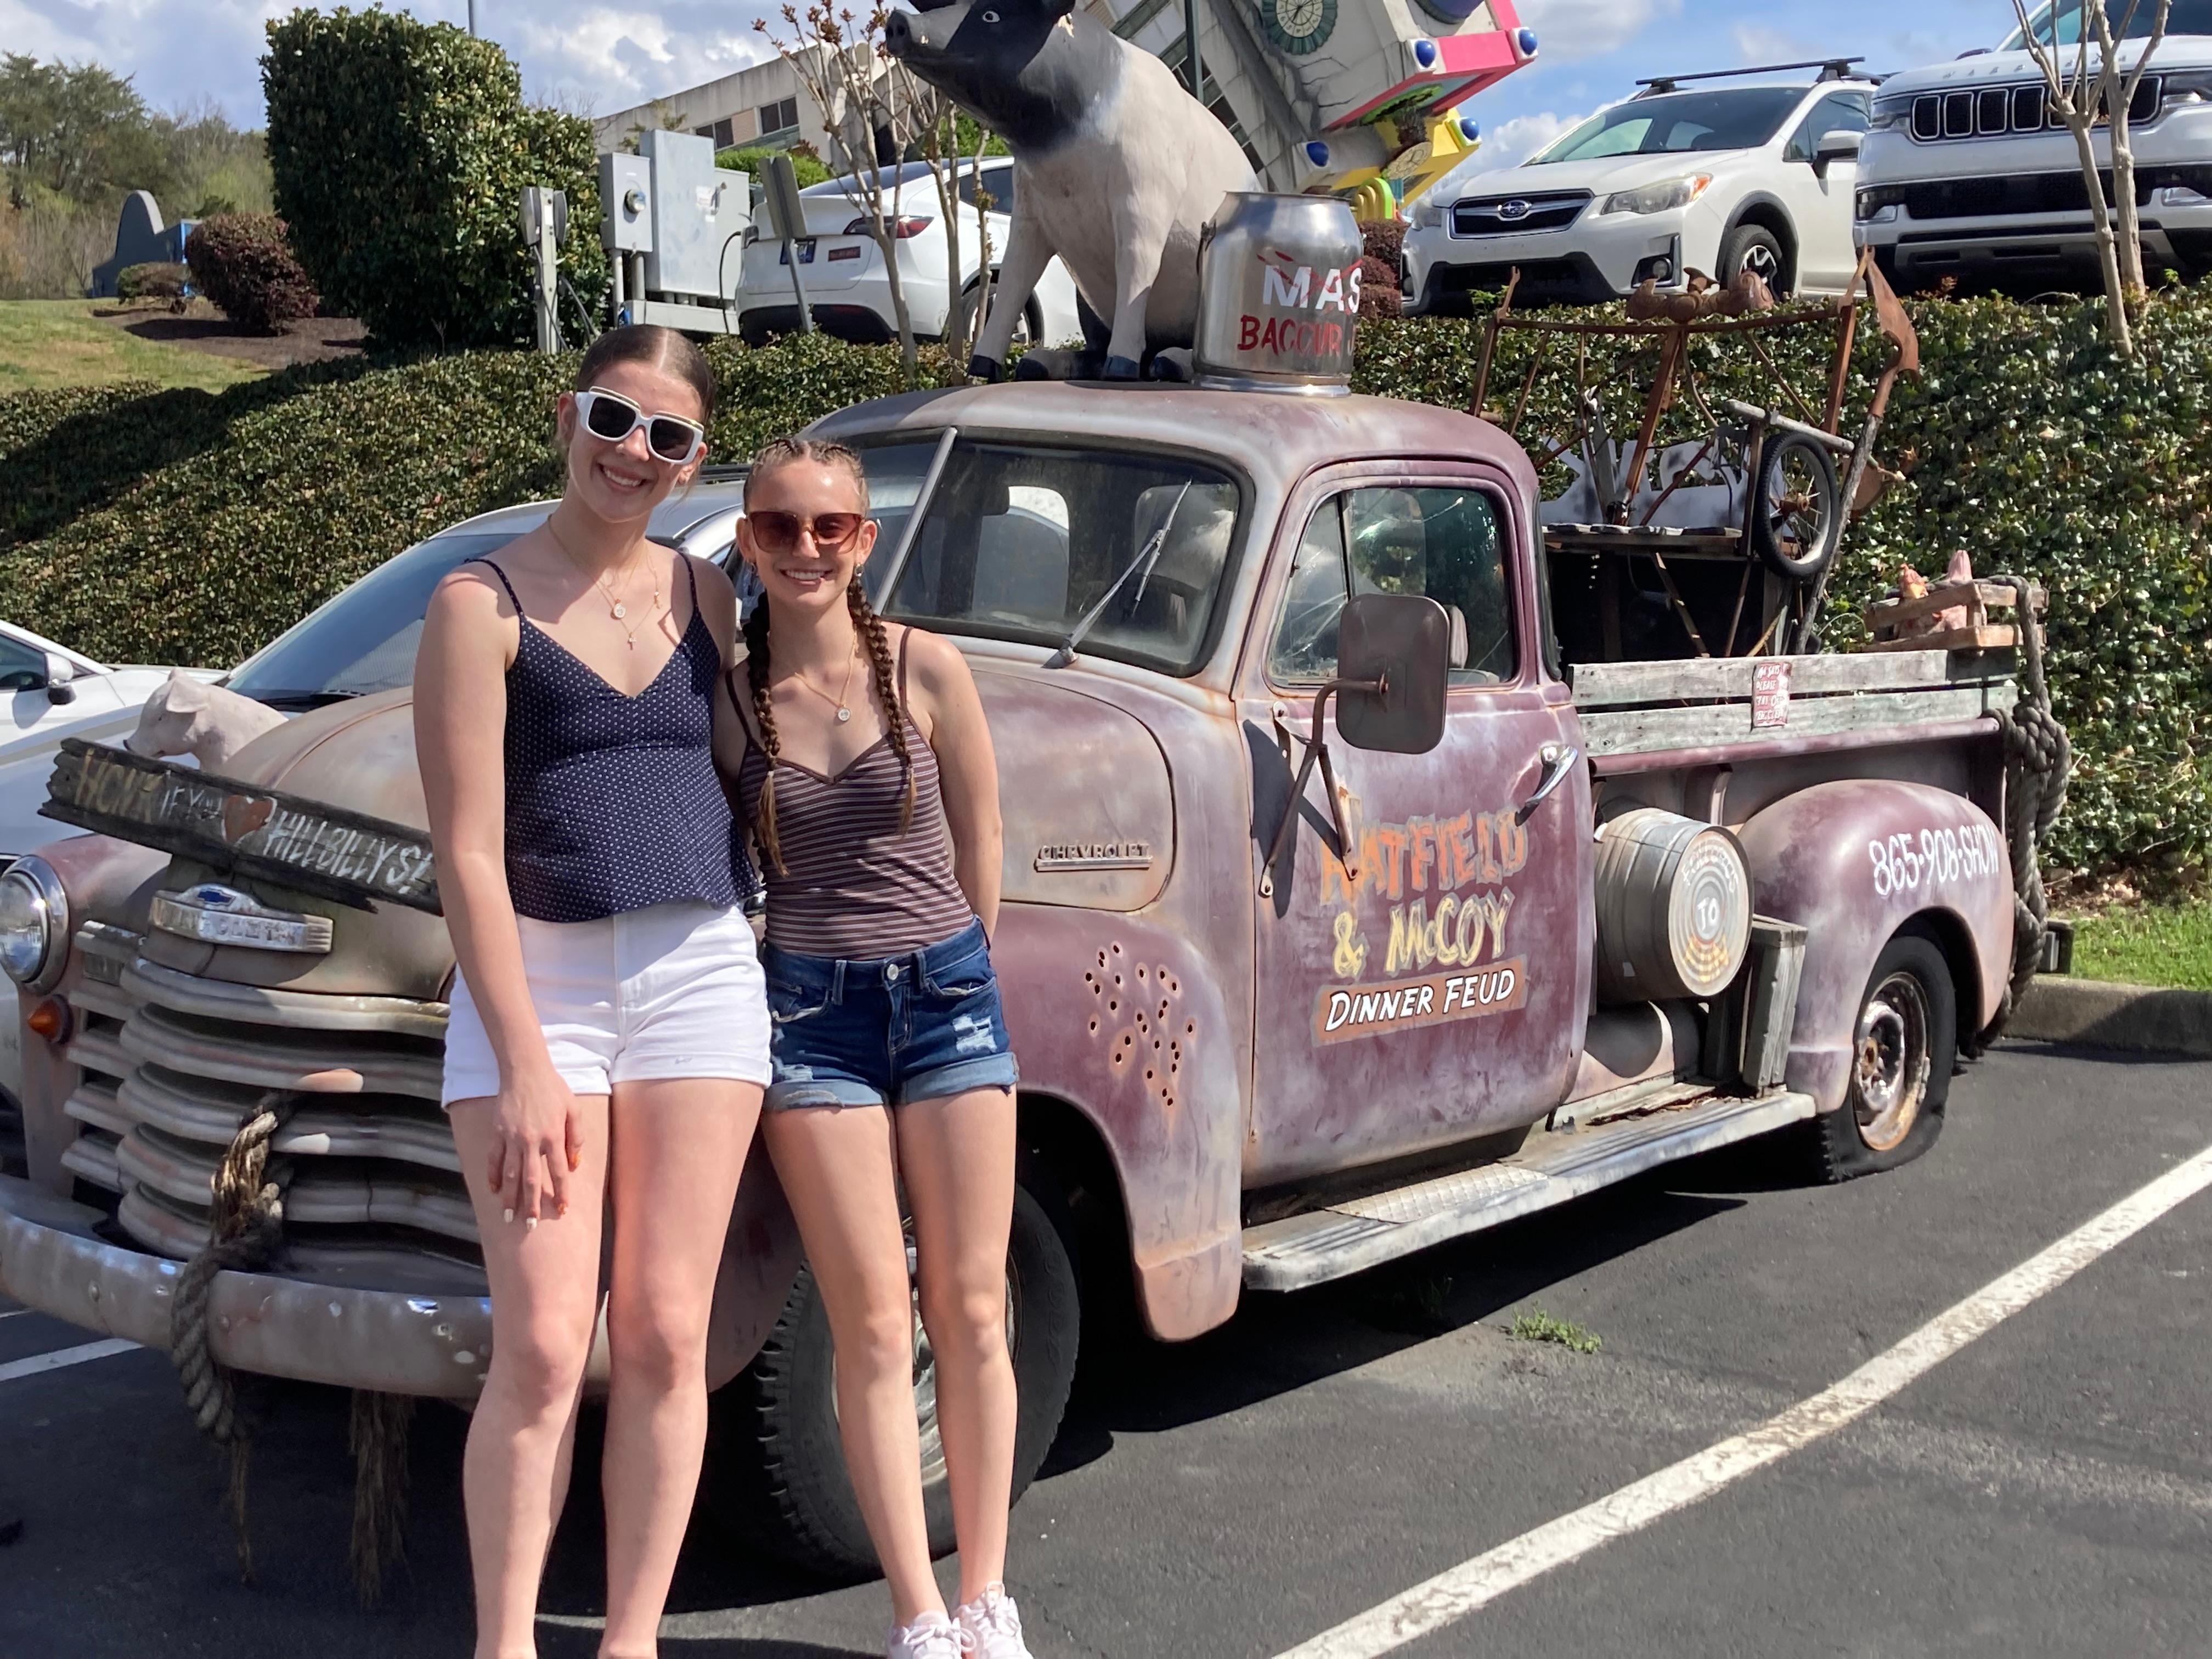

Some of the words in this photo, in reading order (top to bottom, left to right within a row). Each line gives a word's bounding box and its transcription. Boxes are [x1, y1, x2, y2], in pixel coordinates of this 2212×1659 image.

[159, 785, 185, 820] IF
[1039, 843, 1150, 860] CHEVROLET
[1333, 910, 1369, 980] &
[1324, 985, 1435, 1032] DINNER
[1442, 969, 1516, 1015] FEUD
